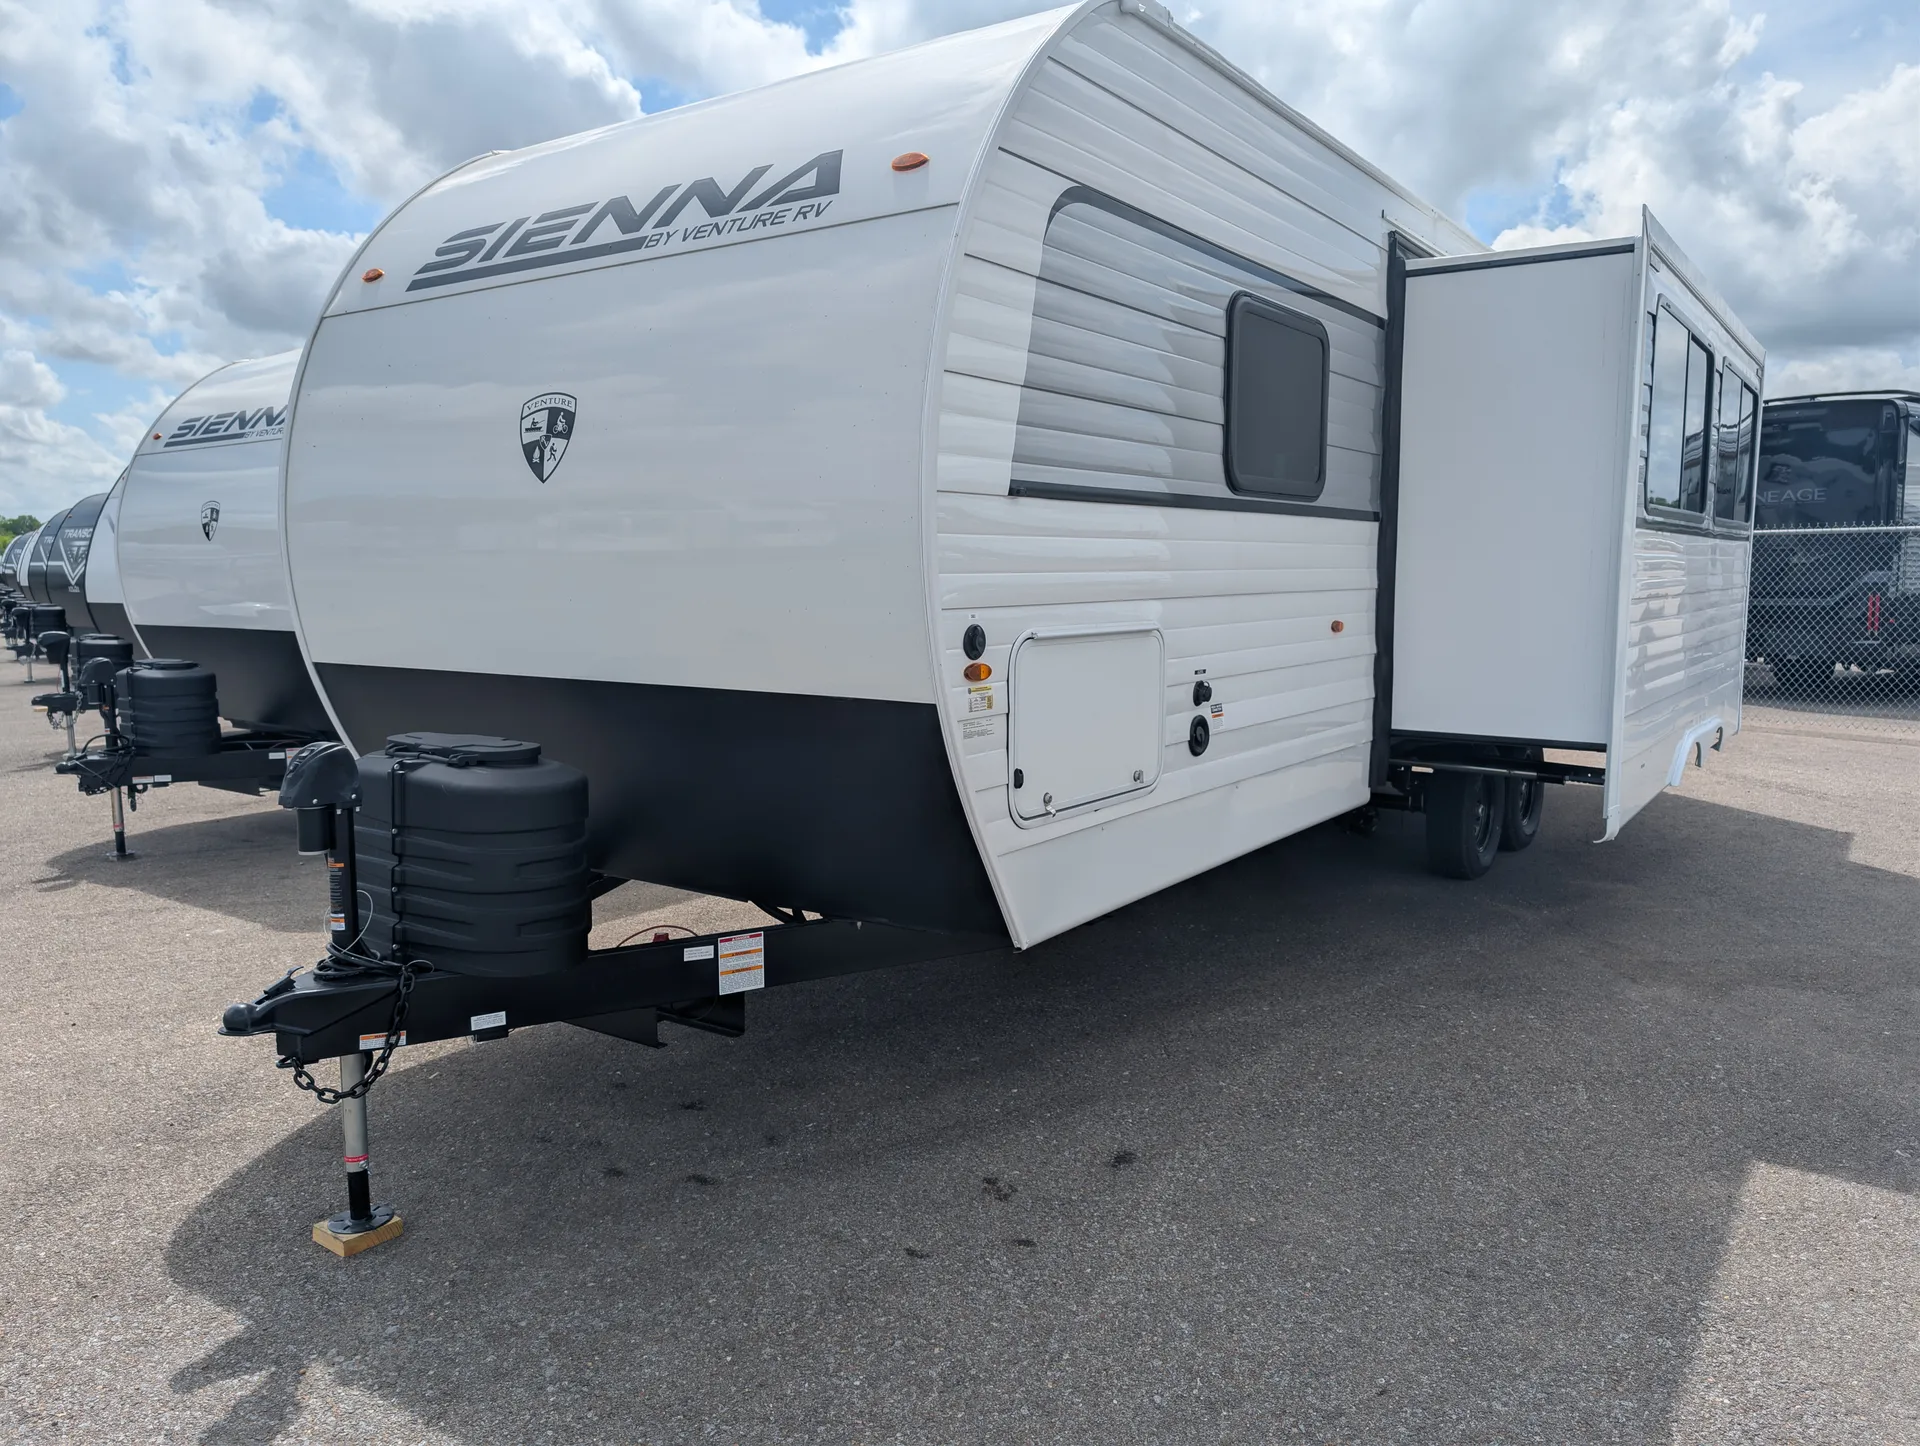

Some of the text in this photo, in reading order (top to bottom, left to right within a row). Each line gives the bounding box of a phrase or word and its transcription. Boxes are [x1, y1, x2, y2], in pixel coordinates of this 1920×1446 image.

[413, 149, 843, 275] SIENNA
[644, 200, 833, 249] BY VENTURE RV
[527, 397, 573, 411] VENTURE
